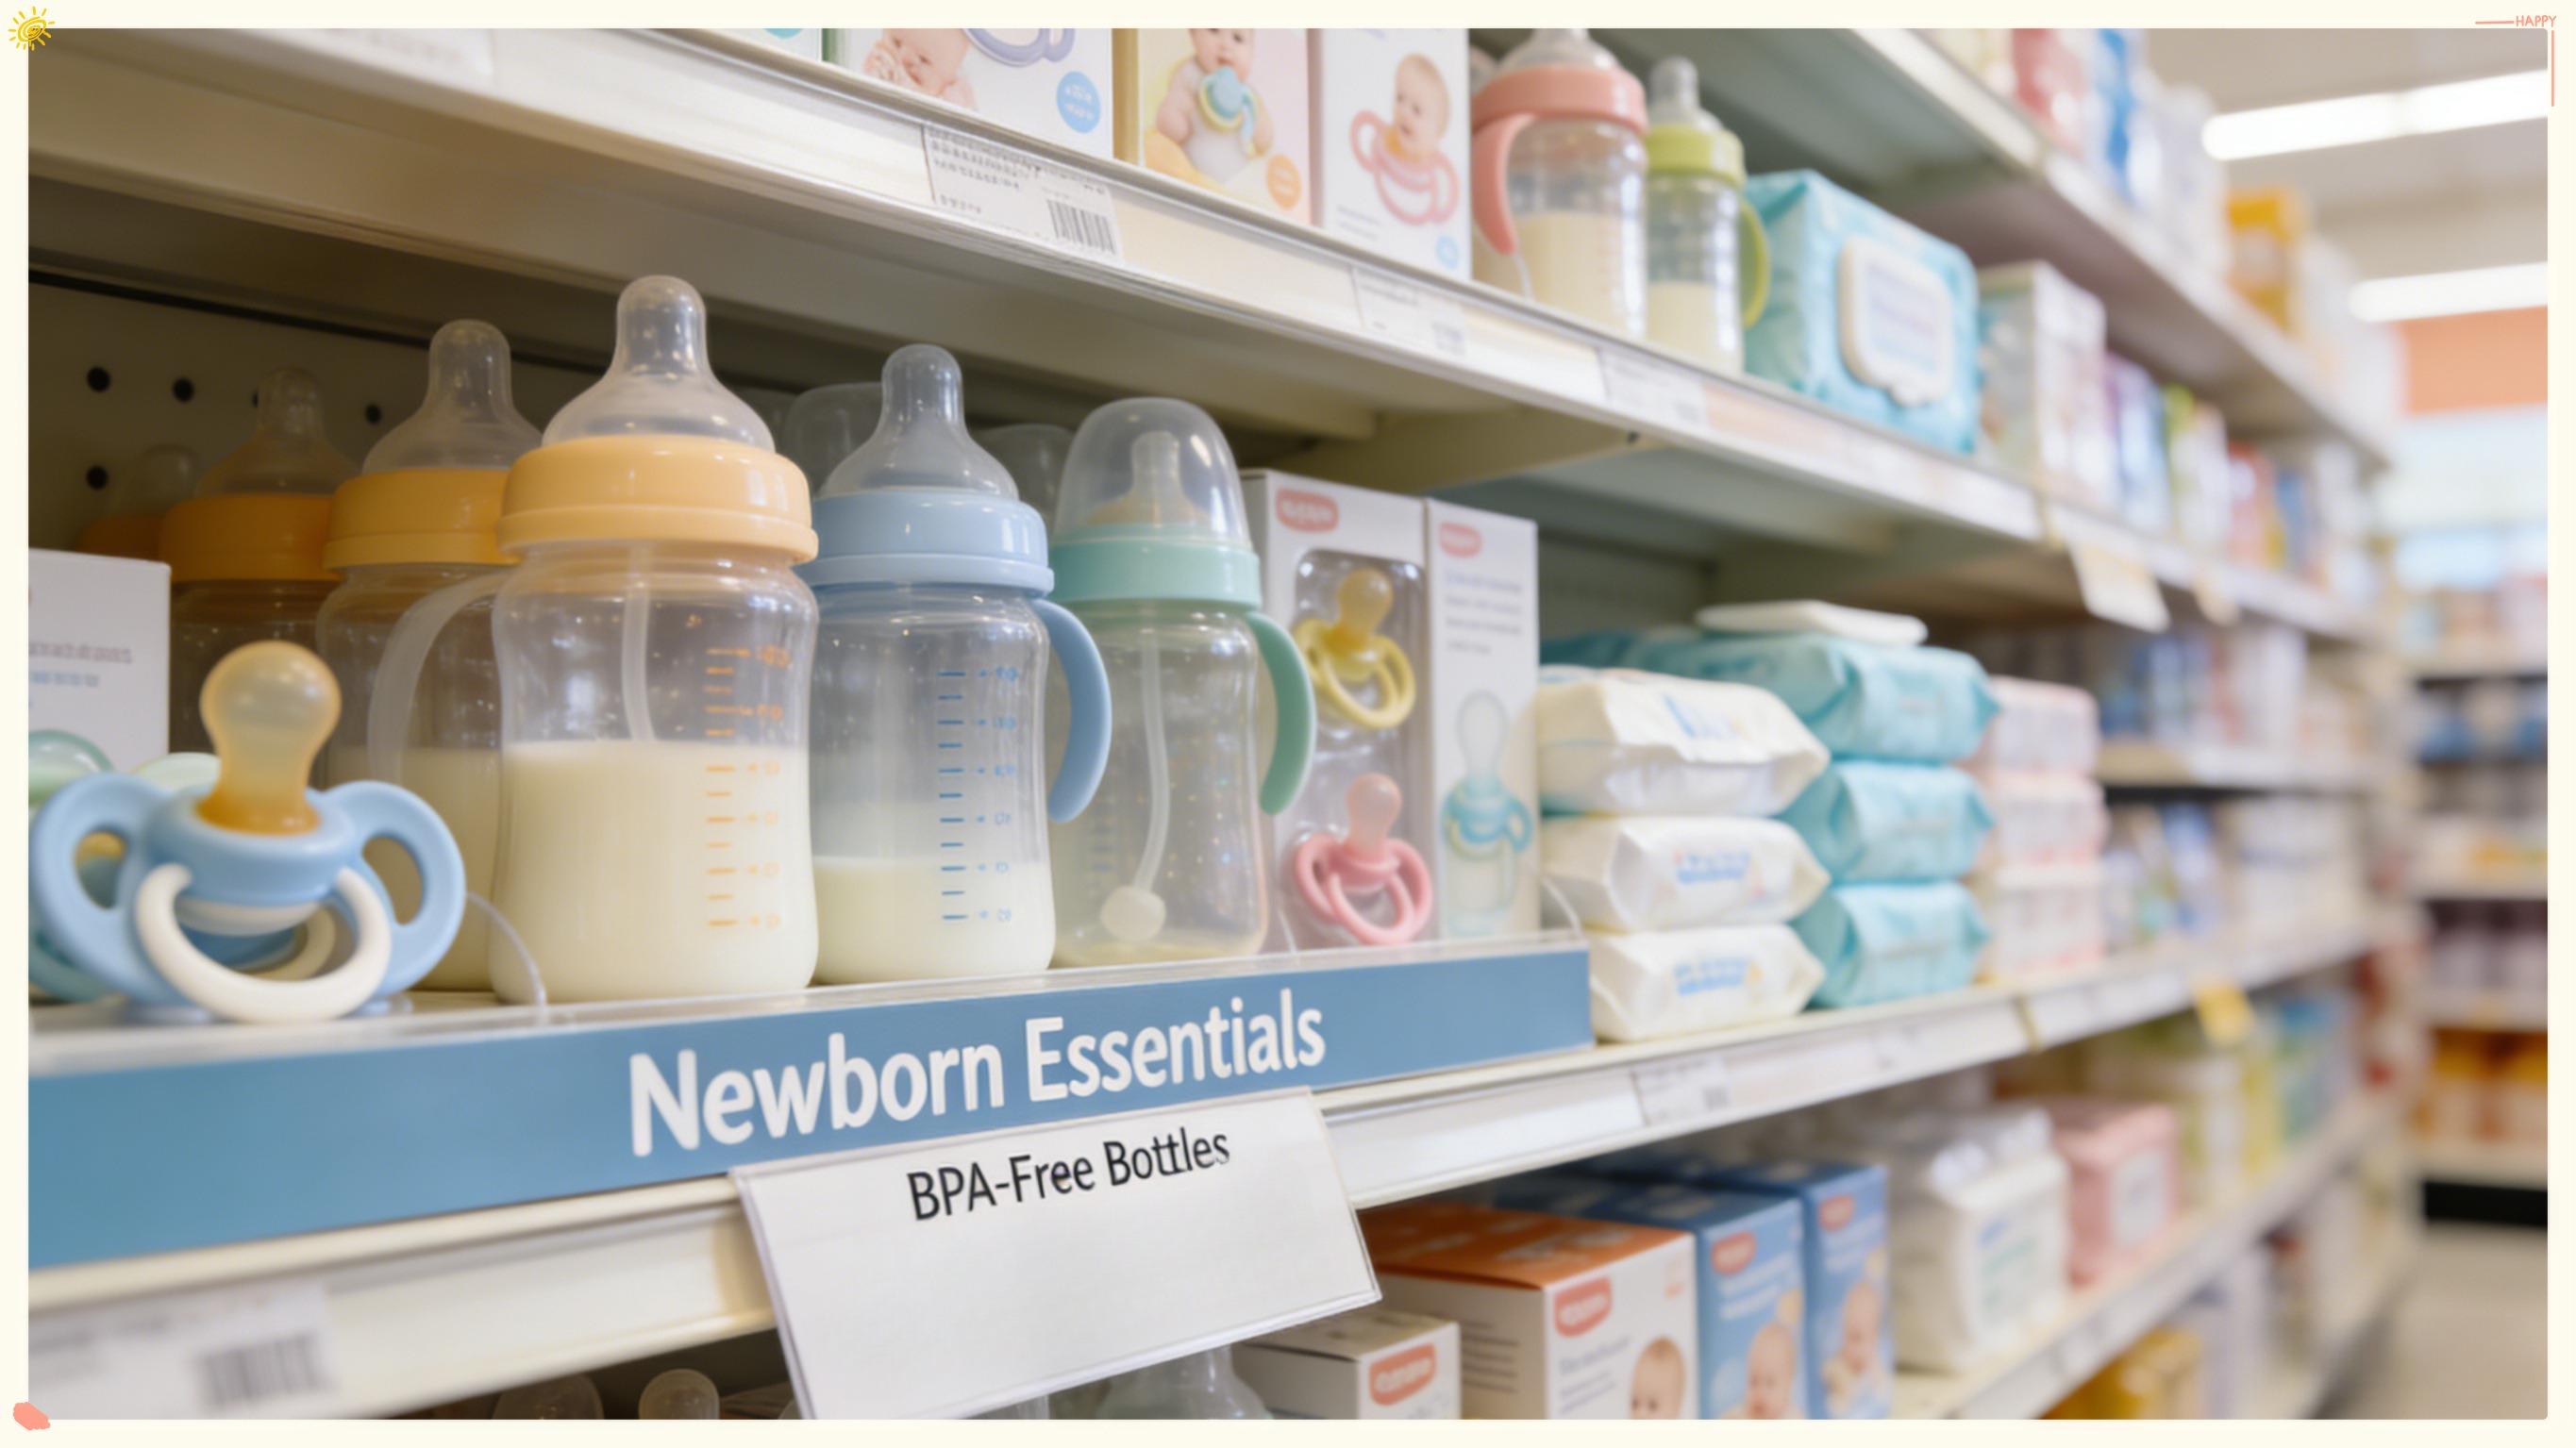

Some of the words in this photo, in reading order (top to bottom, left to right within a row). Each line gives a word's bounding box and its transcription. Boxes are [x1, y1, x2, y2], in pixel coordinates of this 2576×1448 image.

[629, 1032, 1005, 1157] Newborn
[1026, 988, 1326, 1103] Essentials
[906, 1154, 1096, 1222] BPA-Free
[1102, 1126, 1230, 1187] Bottles
